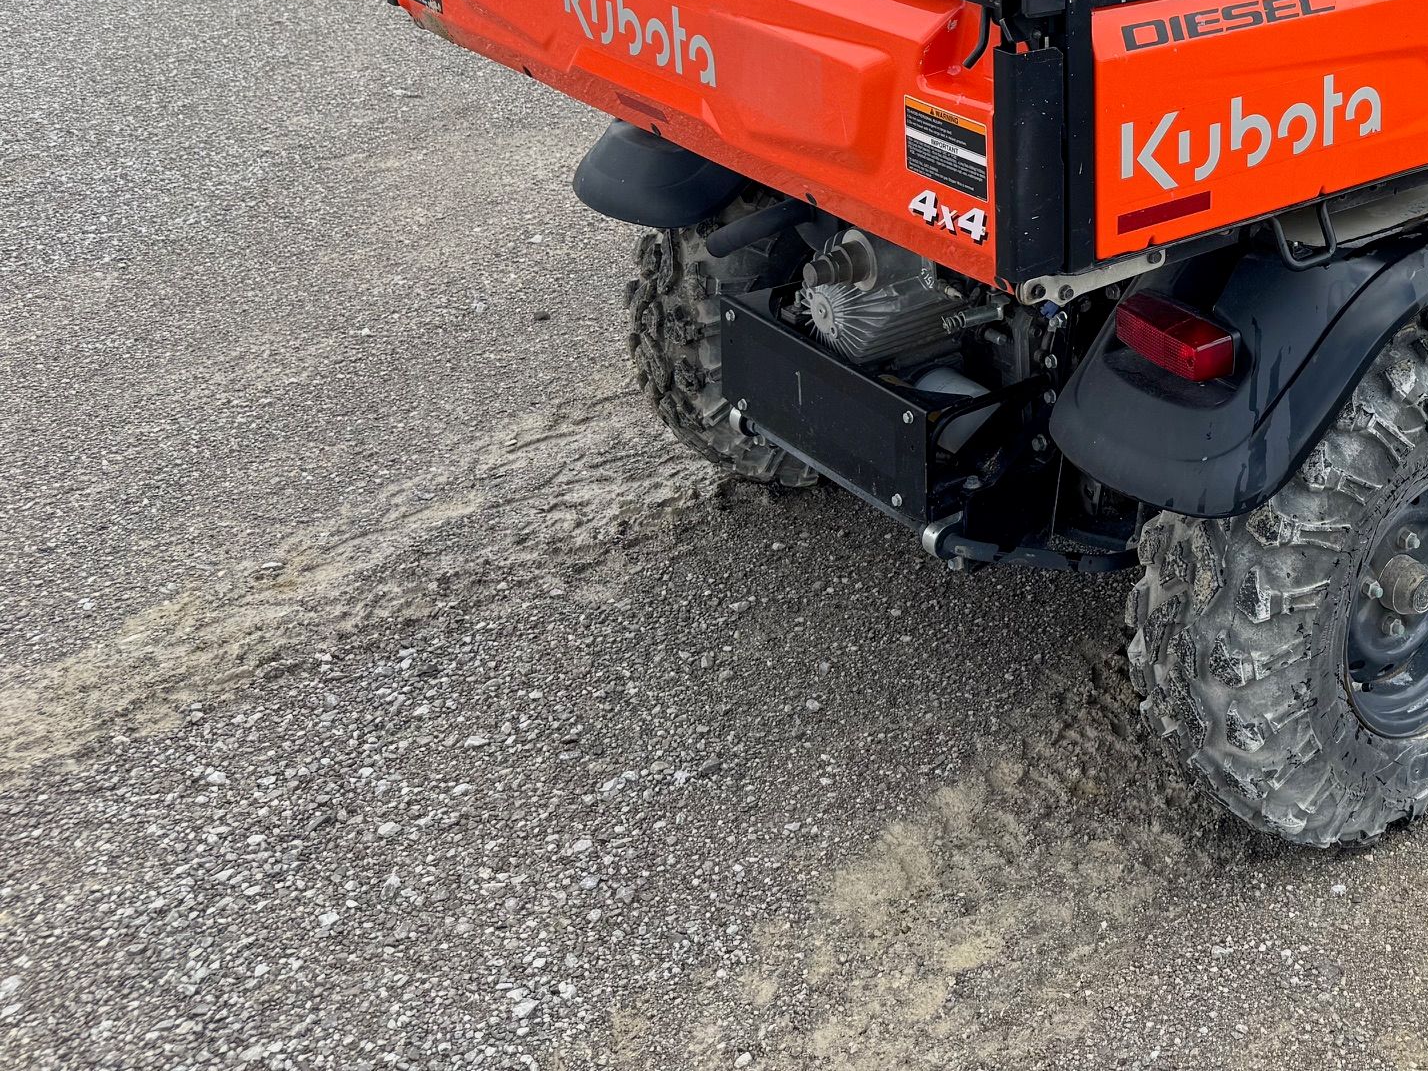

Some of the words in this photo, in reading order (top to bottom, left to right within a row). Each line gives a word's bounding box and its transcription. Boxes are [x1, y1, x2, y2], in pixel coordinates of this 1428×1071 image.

[935, 110, 959, 125] WARNING
[1121, 74, 1381, 191] Kubota
[930, 138, 959, 155] IMPORTANT
[908, 189, 989, 246] 4x4
